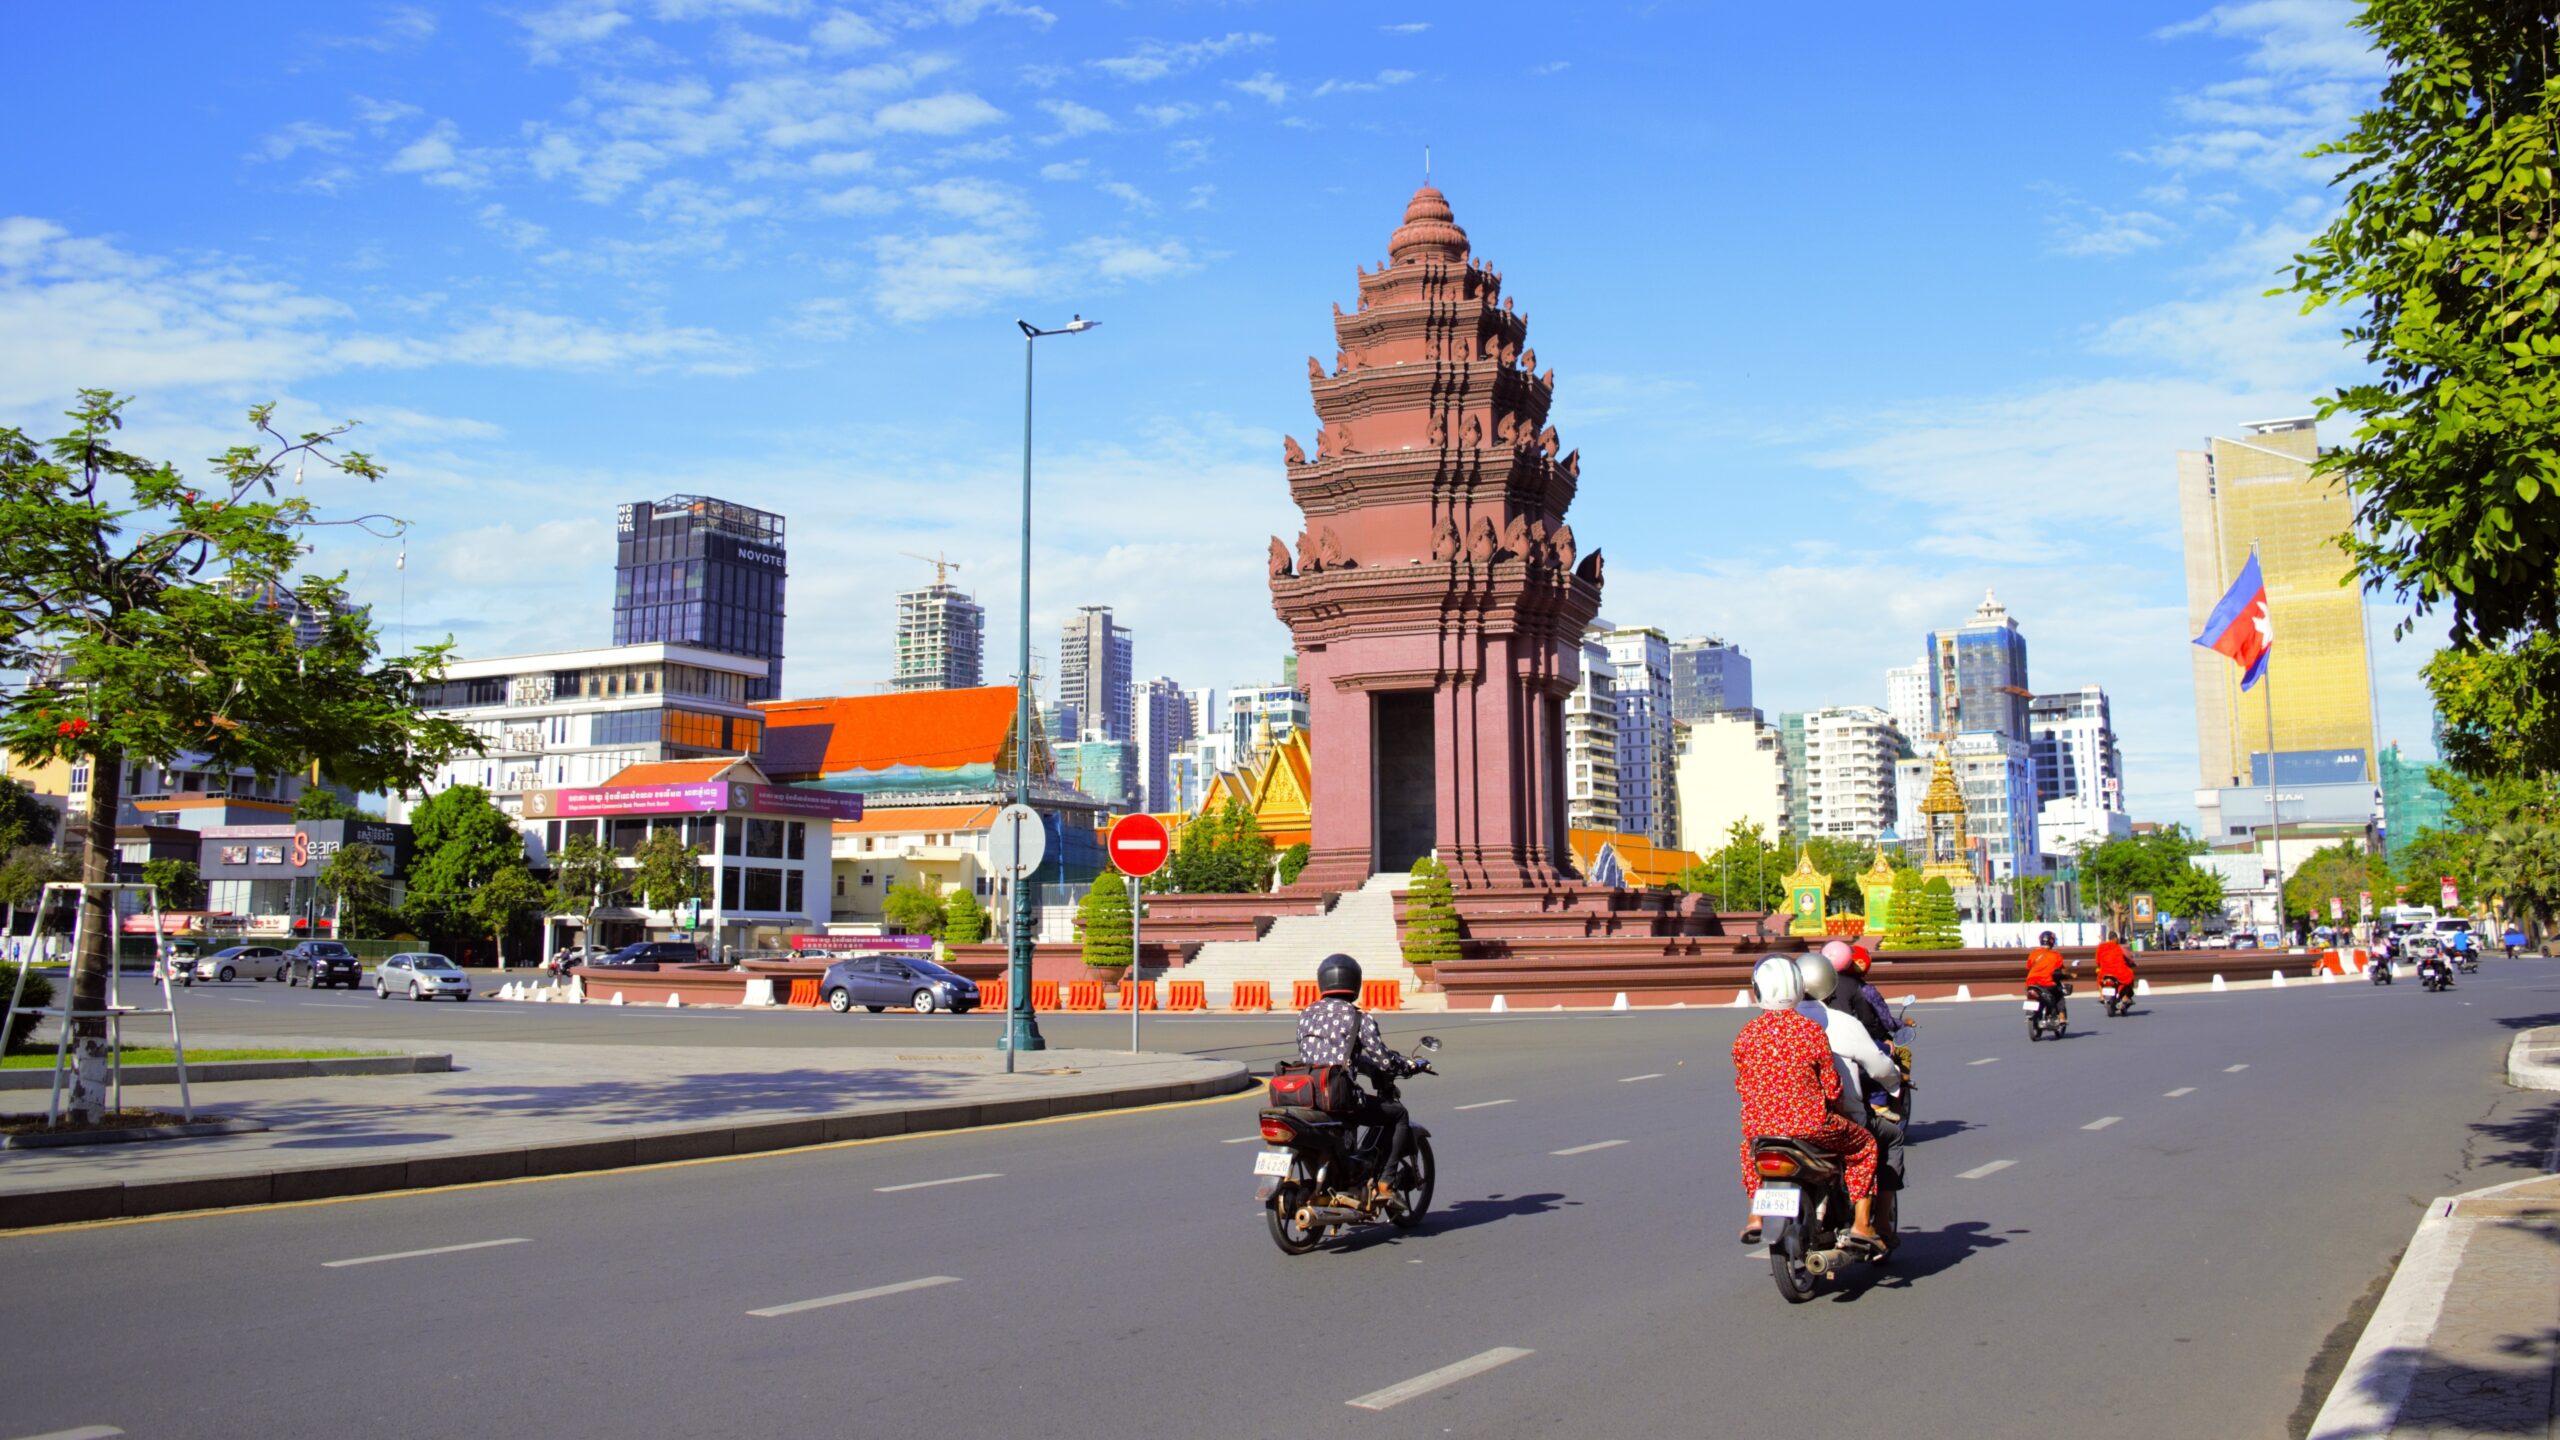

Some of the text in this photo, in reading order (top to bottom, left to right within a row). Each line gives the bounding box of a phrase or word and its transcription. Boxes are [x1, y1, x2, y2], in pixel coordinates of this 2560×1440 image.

[618, 504, 633, 514] NO
[618, 514, 632, 523] VO
[618, 523, 635, 532] TEL
[2336, 755, 2358, 764] ABA
[294, 832, 340, 867] Seara
